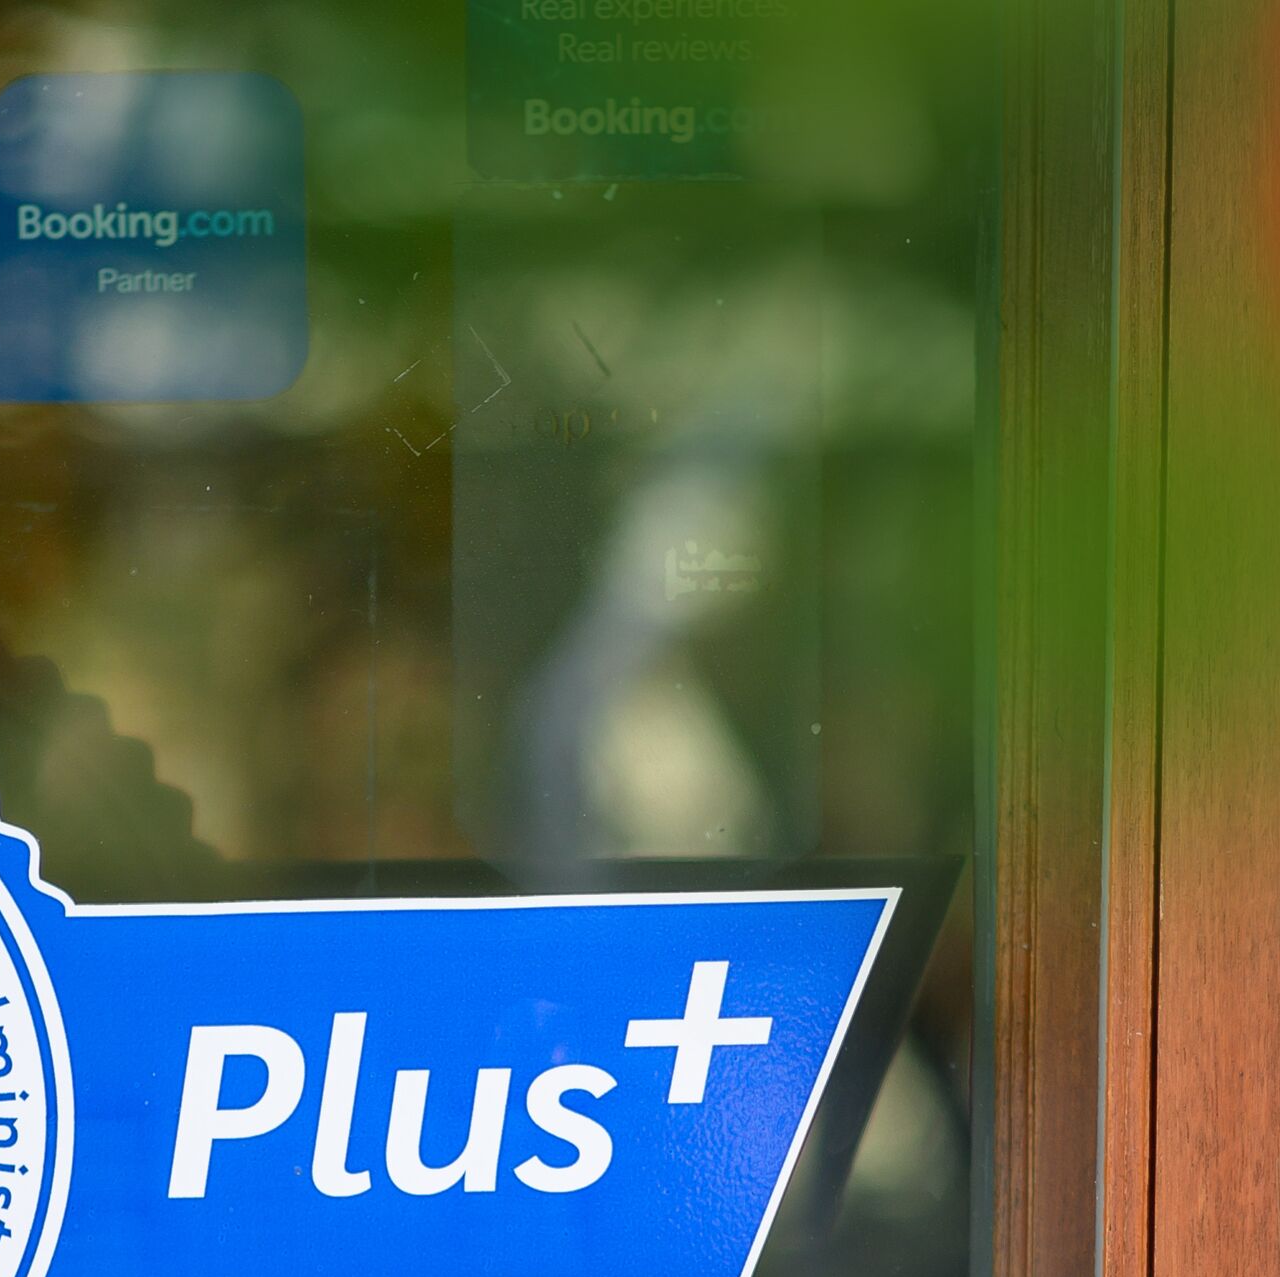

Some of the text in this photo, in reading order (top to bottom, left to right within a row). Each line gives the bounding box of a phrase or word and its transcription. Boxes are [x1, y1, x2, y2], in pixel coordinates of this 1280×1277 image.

[558, 33, 622, 63] Real
[18, 203, 274, 247] Booking.com
[97, 268, 197, 292] Partner
